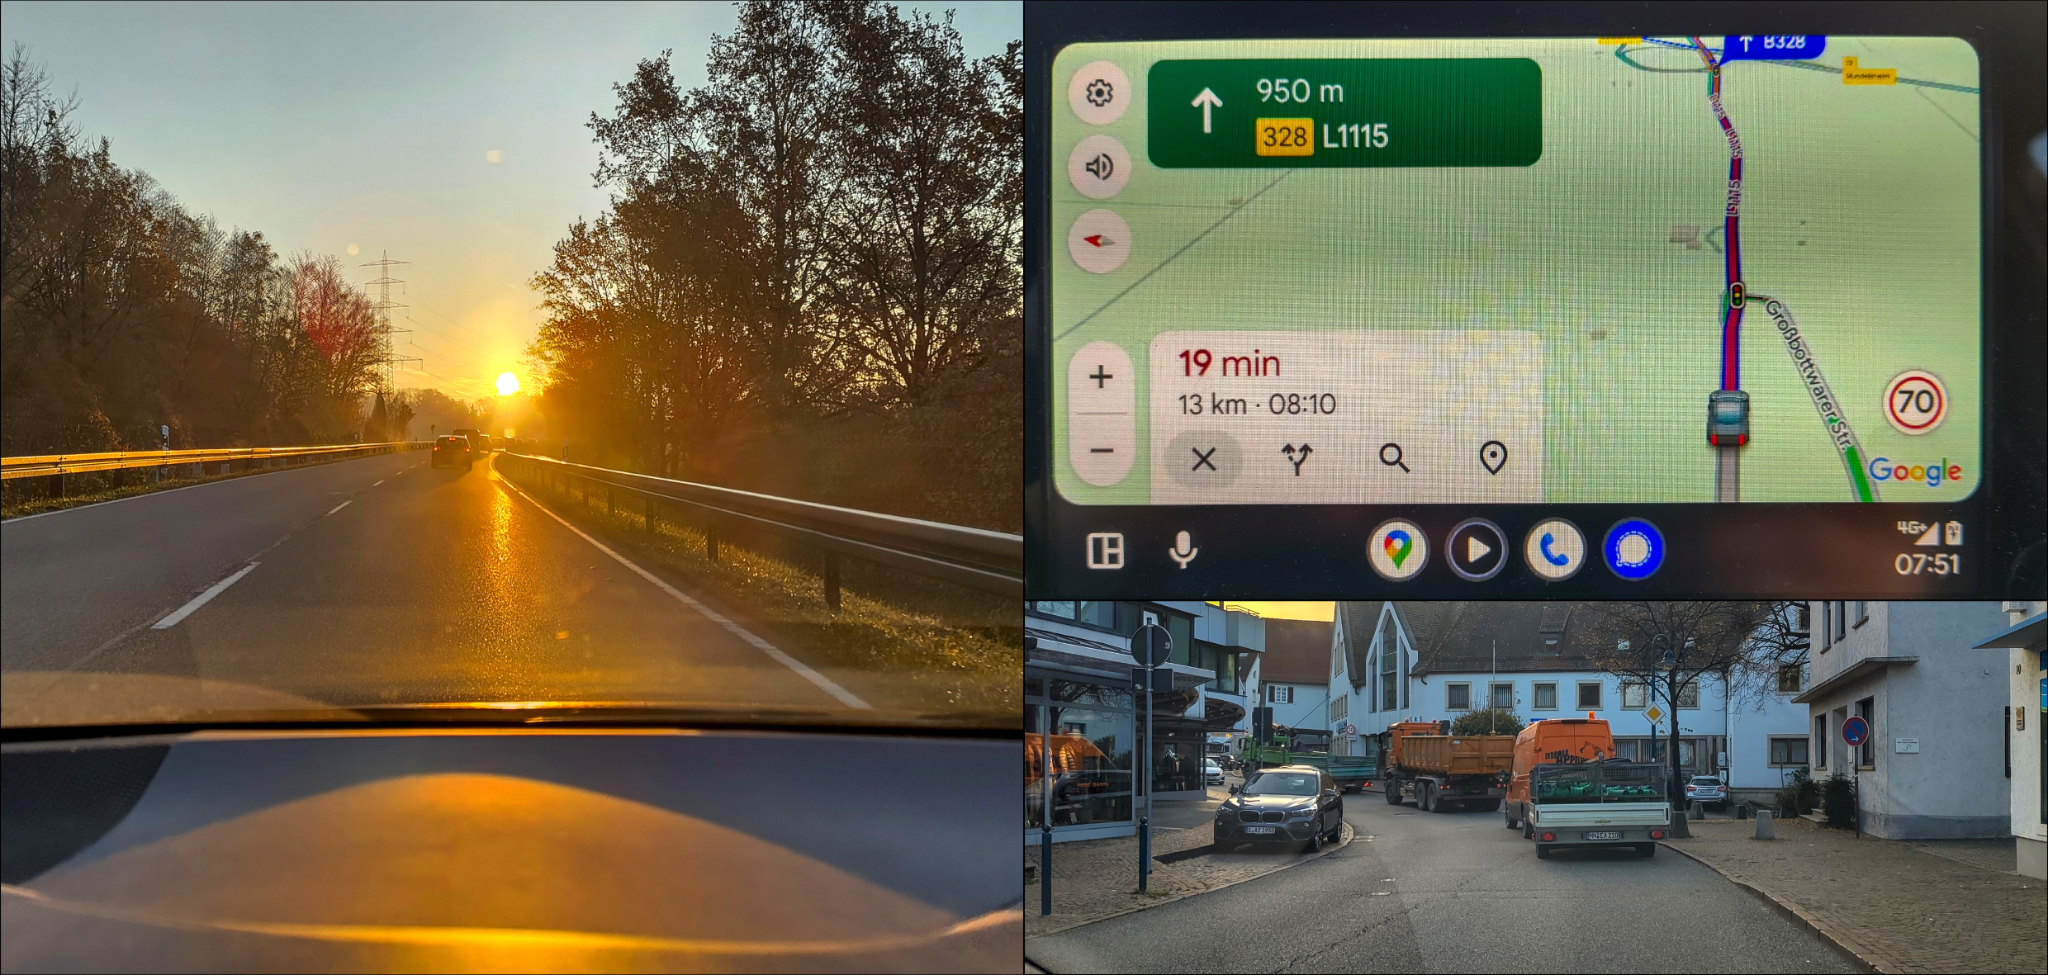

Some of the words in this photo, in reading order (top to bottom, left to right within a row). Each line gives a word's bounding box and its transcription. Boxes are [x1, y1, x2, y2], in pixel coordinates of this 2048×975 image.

[1763, 36, 1807, 49] B328
[1256, 78, 1311, 103] 950
[1319, 83, 1344, 103] m
[1263, 126, 1308, 147] 328
[1323, 123, 1389, 149] L1115
[1726, 180, 1741, 216] L1115
[1179, 348, 1213, 377] 19
[1222, 348, 1281, 377] min
[1766, 300, 1838, 418] Großbottwarer
[1831, 421, 1852, 451] Str.
[1178, 393, 1203, 415] 13
[1211, 391, 1248, 415] km
[1268, 392, 1337, 415] 08:10
[1898, 389, 1935, 414] 70
[1868, 456, 1963, 488] Google
[1896, 520, 1929, 535] 4G+
[1894, 553, 1961, 576] 07:51
